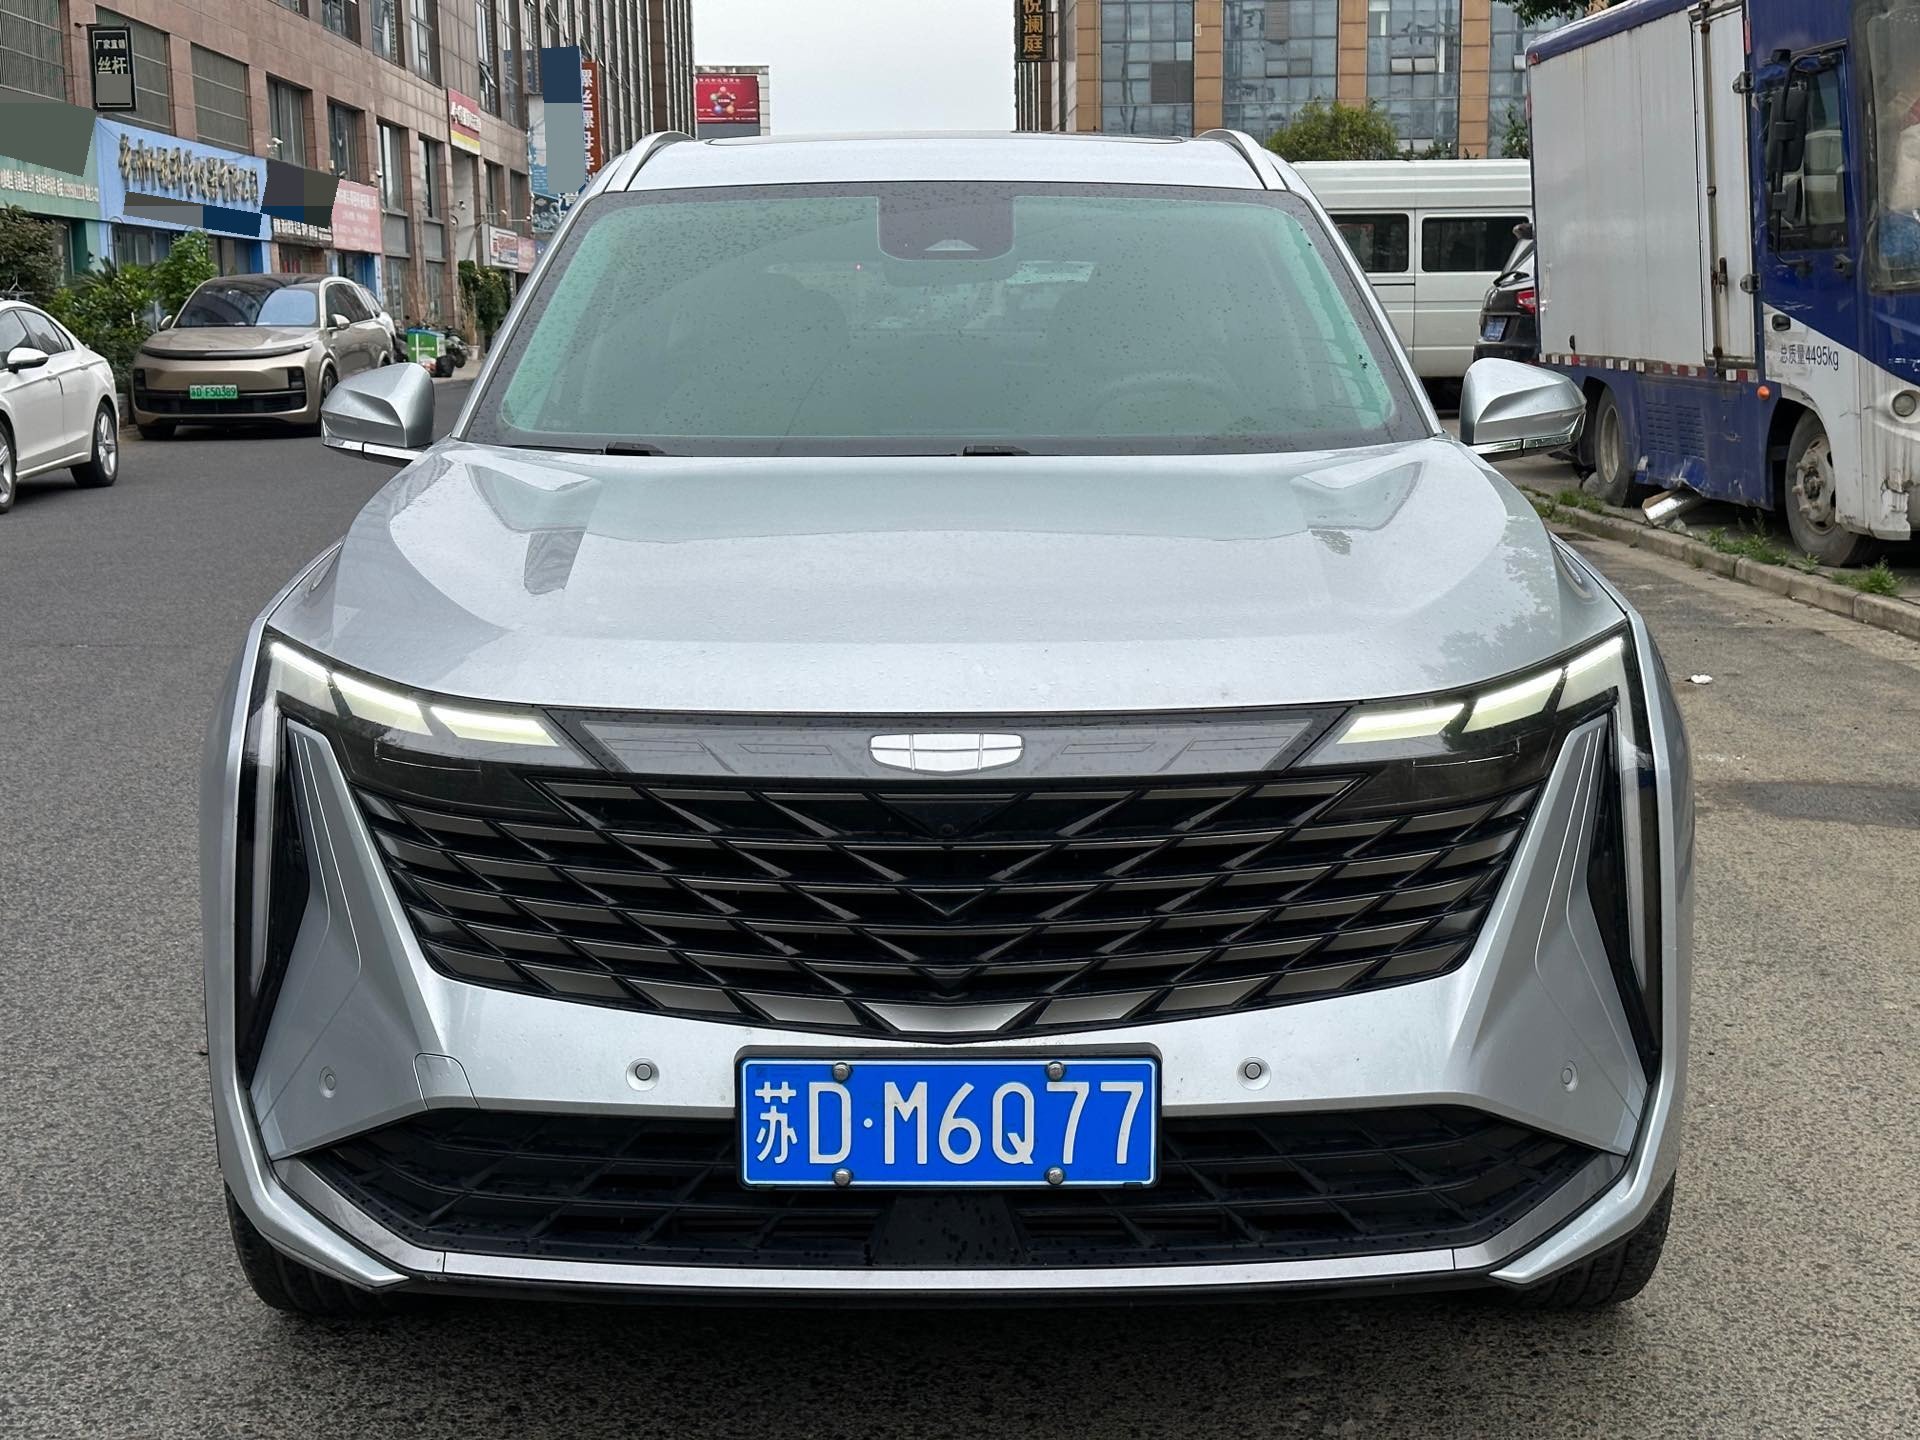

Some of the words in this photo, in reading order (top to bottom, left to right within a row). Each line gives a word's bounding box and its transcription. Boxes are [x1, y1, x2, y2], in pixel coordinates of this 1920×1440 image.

[1780, 343, 1839, 371] 总质量4495kg
[755, 1081, 1144, 1165] 苏D·M6Q77
